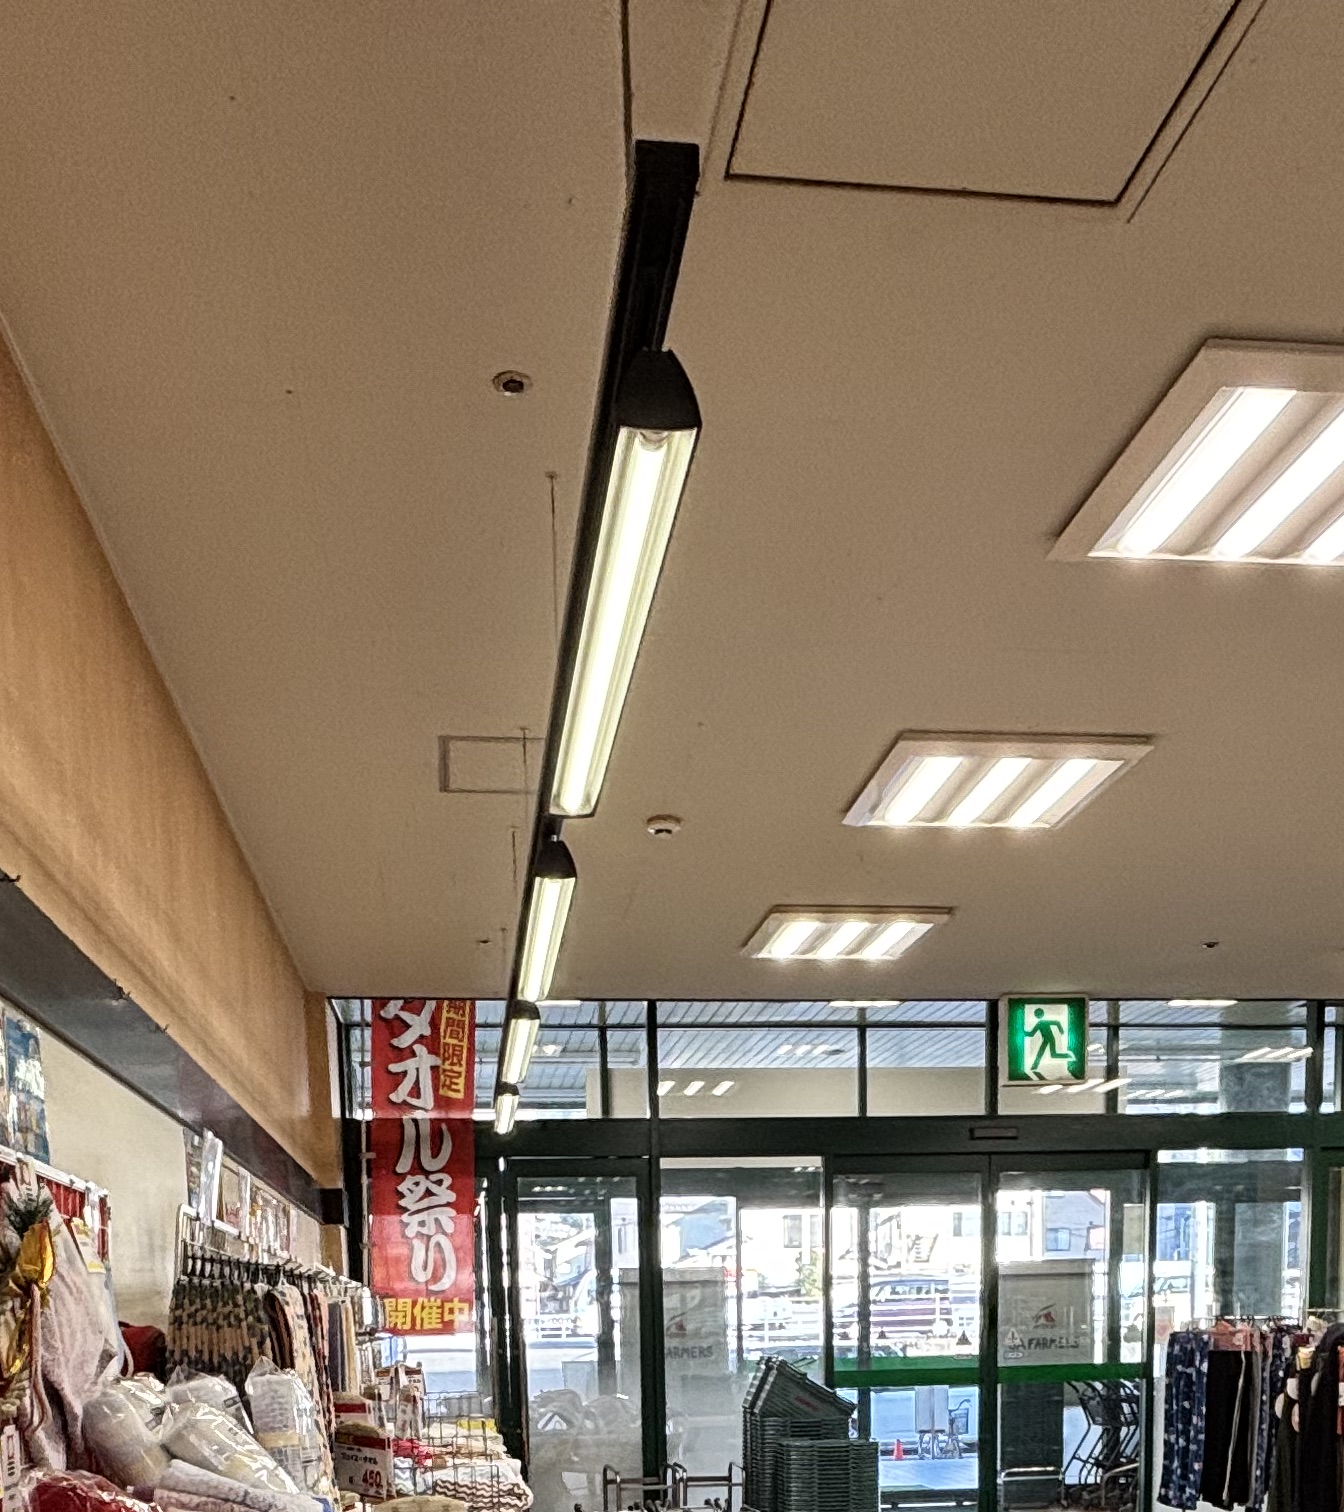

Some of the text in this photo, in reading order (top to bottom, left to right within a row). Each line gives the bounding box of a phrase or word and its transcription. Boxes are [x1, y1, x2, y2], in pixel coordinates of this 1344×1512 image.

[385, 1296, 470, 1331] 開催中
[666, 1345, 713, 1359] ARMERS
